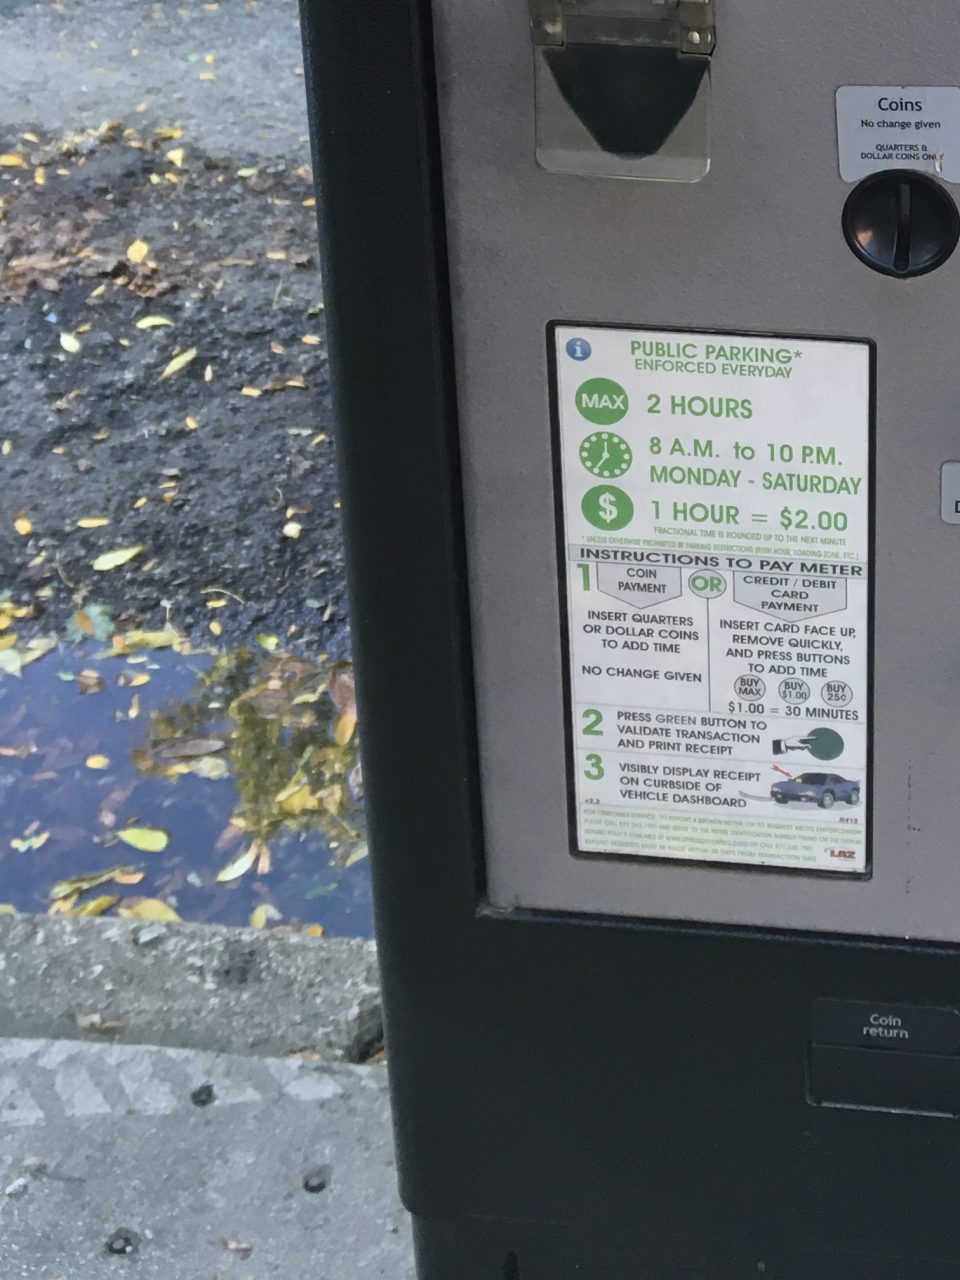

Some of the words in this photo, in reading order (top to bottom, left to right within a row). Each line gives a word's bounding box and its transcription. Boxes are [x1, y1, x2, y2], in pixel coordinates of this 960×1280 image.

[878, 98, 922, 111] Coins
[877, 120, 911, 129] change
[915, 120, 941, 130] given
[630, 340, 697, 359] PUBLIC
[635, 359, 716, 375] ENFORCED
[722, 364, 792, 378] EVERYDAY
[582, 393, 625, 409] MAX
[647, 394, 661, 414] 2
[671, 395, 752, 419] HOURS
[649, 437, 661, 455] 8
[669, 439, 720, 458] A.M.
[733, 441, 755, 460] to
[768, 443, 793, 463] 10
[802, 445, 842, 465] P.M.
[650, 465, 741, 488] MONDAY
[762, 472, 862, 495] SATURDAY
[652, 501, 660, 520] 1
[673, 502, 739, 524] HOUR
[752, 512, 768, 522] =
[780, 506, 848, 531] $2.00
[580, 548, 719, 567] INSTRUCTIONS
[726, 557, 752, 569] TO
[760, 559, 793, 572] PAY
[800, 563, 863, 576] METER
[691, 577, 723, 592] OR
[582, 665, 601, 676] NO
[606, 666, 659, 680] CHANGE
[664, 670, 702, 682] GIVEN
[582, 709, 604, 736] 2
[617, 711, 652, 722] PRESS
[655, 714, 696, 725] GREEN
[701, 716, 746, 729] BUTTON
[751, 720, 767, 731] TO
[617, 725, 671, 738] VALIDATE
[676, 729, 760, 744] TRANSACTION
[618, 738, 645, 749] AND
[649, 740, 681, 752] PRINT
[685, 743, 733, 756] RECEIPT
[584, 753, 605, 780] 3
[870, 1014, 901, 1026] Coin
[863, 1027, 908, 1039] return
